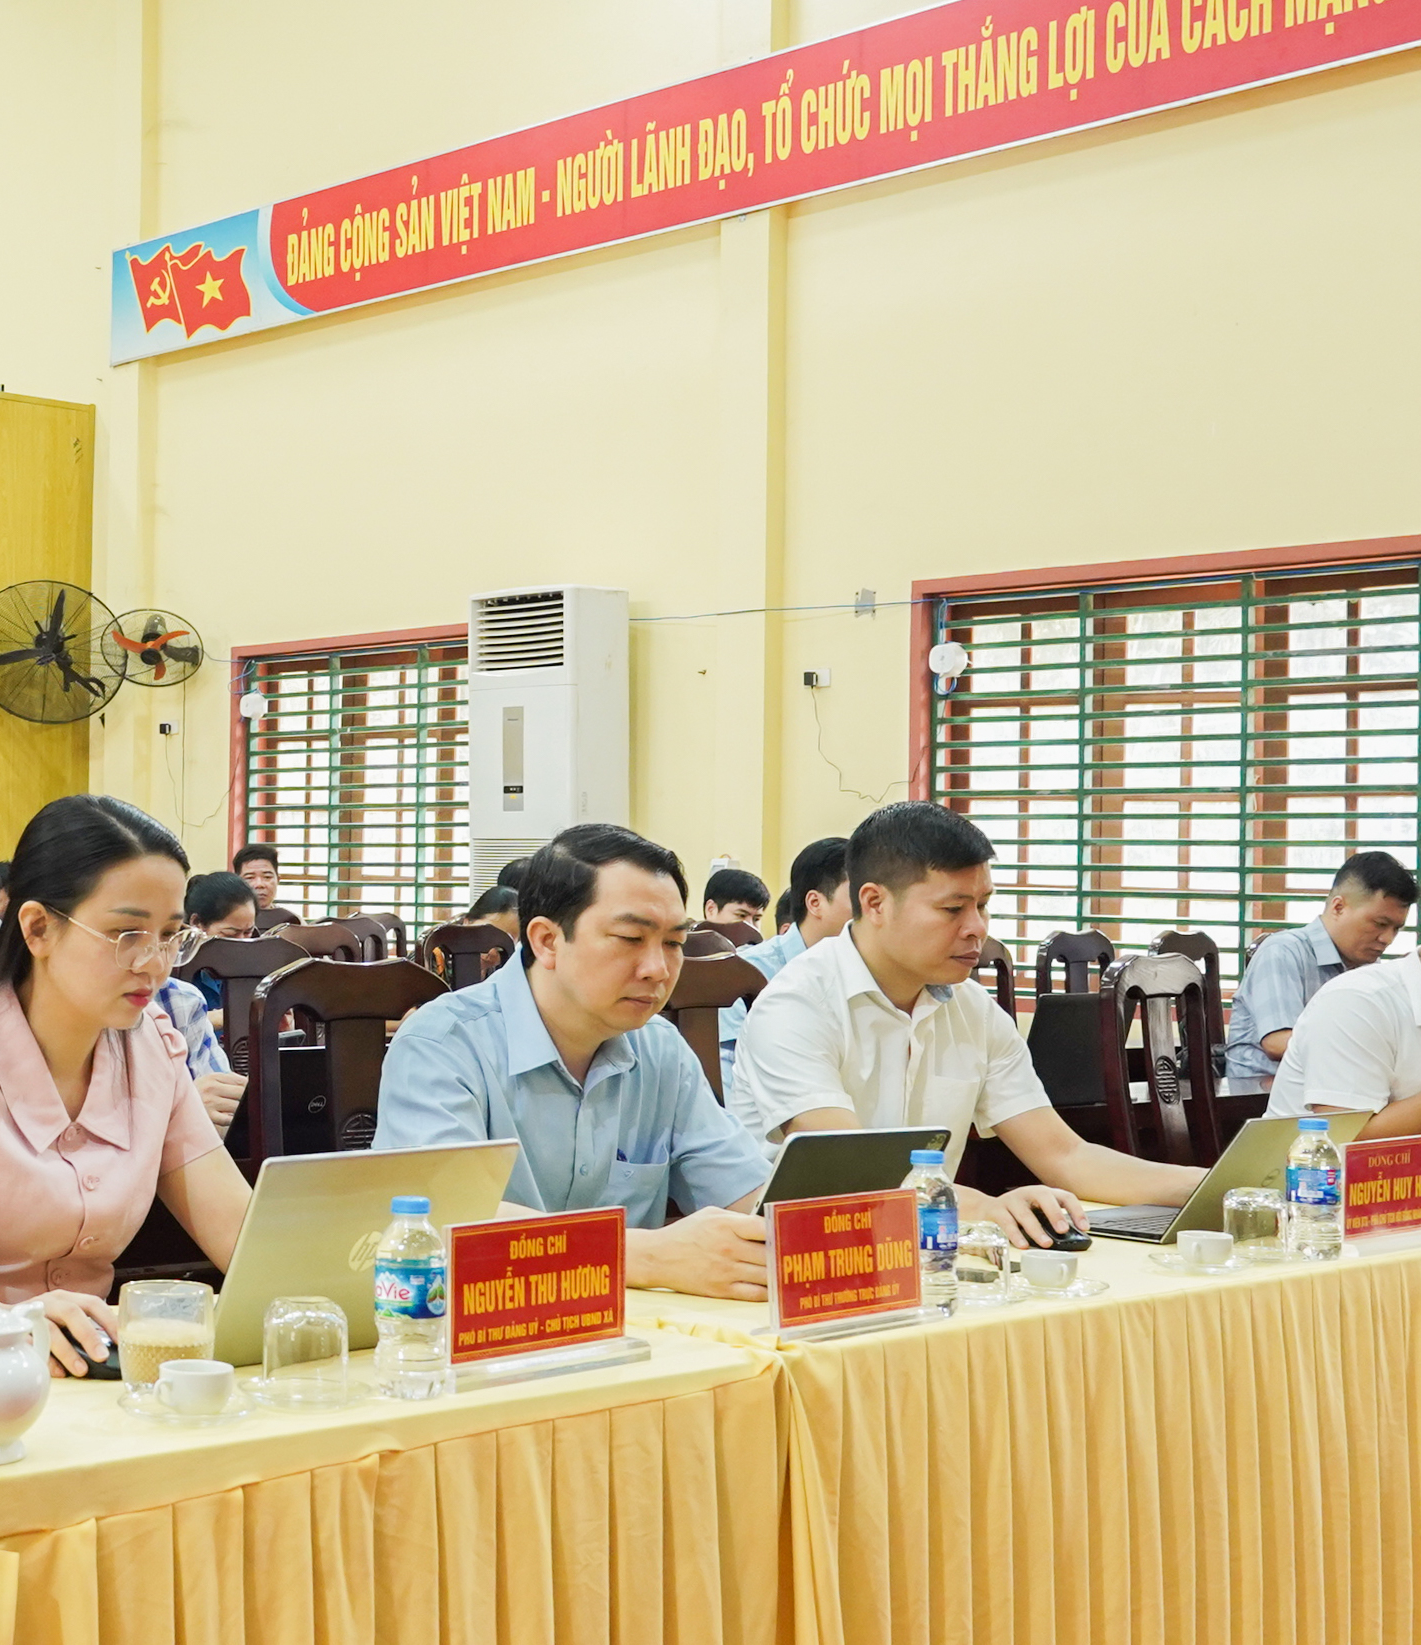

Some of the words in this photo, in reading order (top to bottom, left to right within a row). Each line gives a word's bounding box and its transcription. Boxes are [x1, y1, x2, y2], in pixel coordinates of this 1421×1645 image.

[287, 207, 334, 286] ĐẢNG
[340, 204, 390, 281] CỘNG
[395, 175, 435, 258] SẢN
[440, 173, 482, 254] VIỆT
[487, 167, 535, 235] NAM
[556, 130, 624, 218] NGƯỜI
[631, 121, 691, 196] LÃNH
[698, 107, 755, 190] ĐẠO,
[762, 69, 795, 164] TỔ
[801, 60, 871, 154] CHỨC
[880, 56, 932, 141] MỌI
[942, 14, 1038, 117] THẮNG
[1048, 6, 1095, 100] LỢI
[1348, 1171, 1391, 1207] NGUYỄN
[1393, 1176, 1413, 1200] HUY
[547, 1230, 567, 1255] CHÍ
[783, 1251, 825, 1288] PHẠM
[828, 1244, 874, 1278] TRUNG
[876, 1236, 913, 1271] DŨNG
[463, 1266, 526, 1315] NGUYỄN
[529, 1273, 557, 1306] THU
[561, 1264, 610, 1301] HƯƠNG
[458, 1328, 476, 1347] PHÓ
[488, 1326, 504, 1342] THƯ
[505, 1321, 527, 1339] ĐẢNG
[545, 1314, 561, 1333] CHỦ
[562, 1314, 579, 1332] TỊCH
[581, 1311, 602, 1327] UBND
[603, 1307, 614, 1324] XÃ
